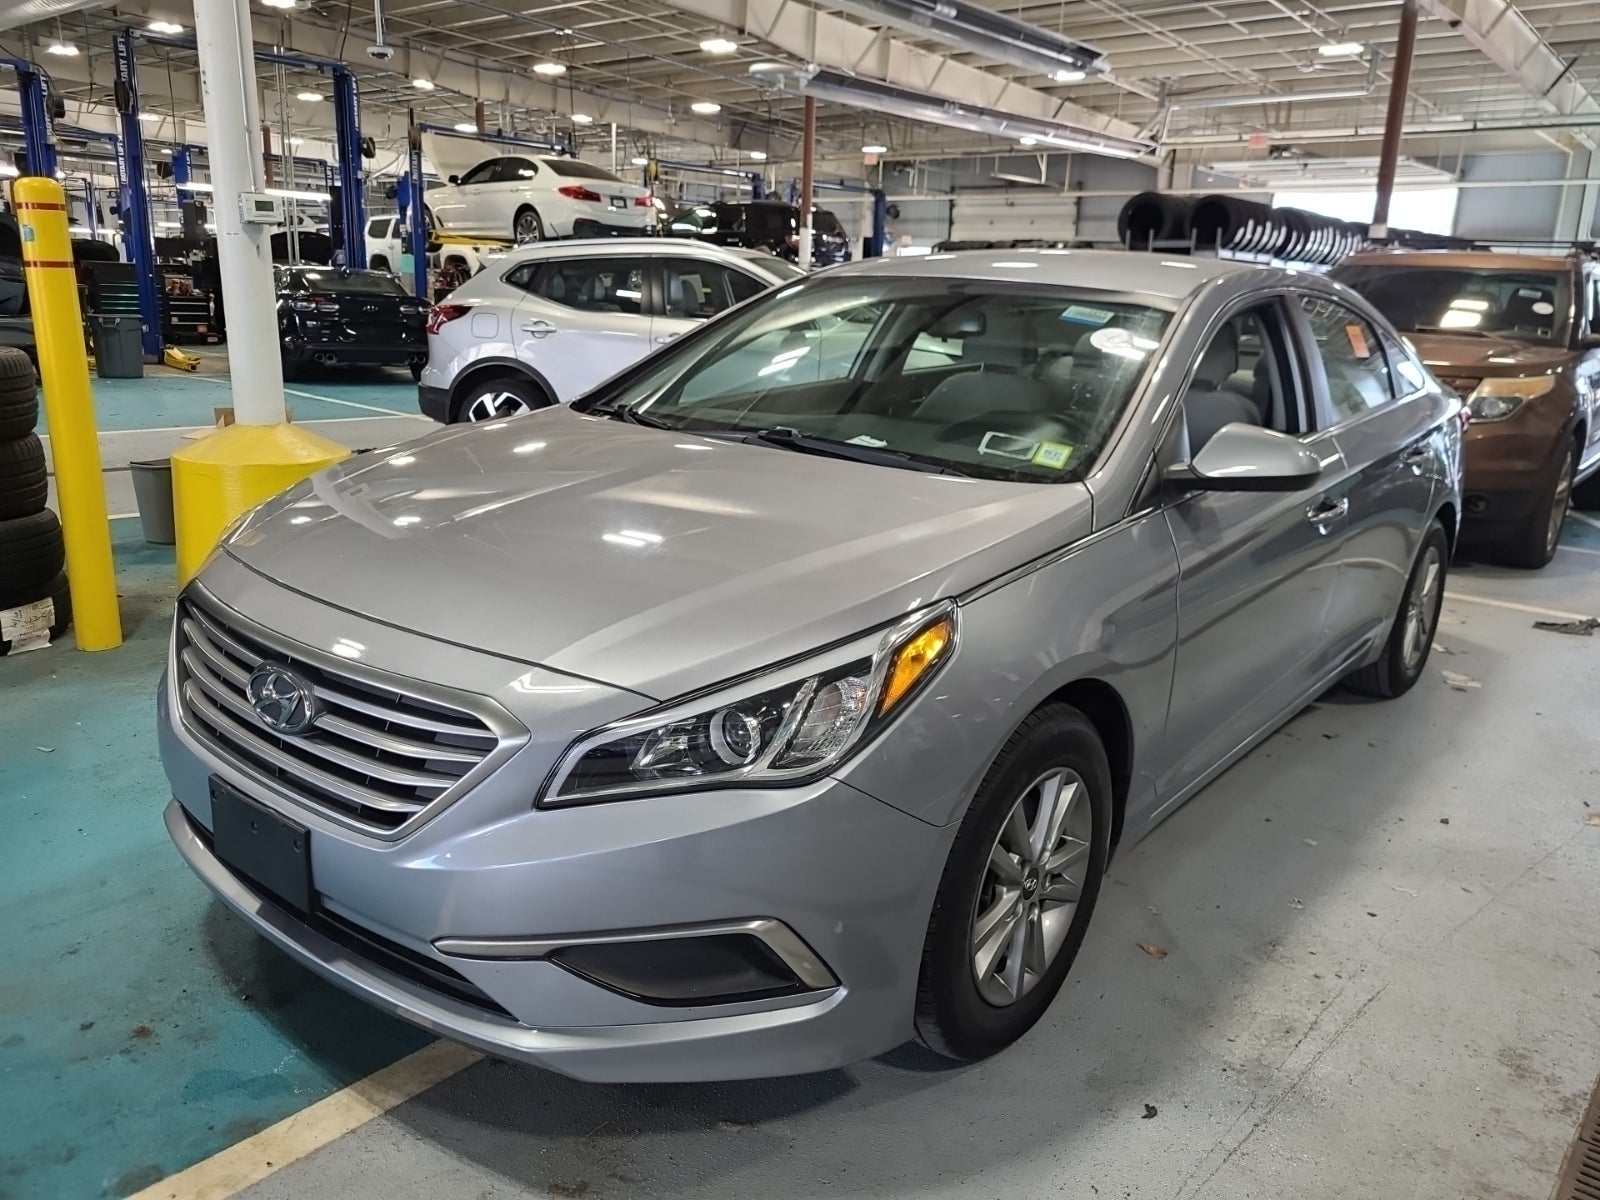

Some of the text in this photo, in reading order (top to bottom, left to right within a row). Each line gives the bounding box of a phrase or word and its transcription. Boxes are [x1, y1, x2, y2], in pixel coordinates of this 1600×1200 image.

[117, 36, 129, 82] TARY LIFT
[40, 75, 48, 96] LIFT
[118, 157, 126, 182] ROTARY
